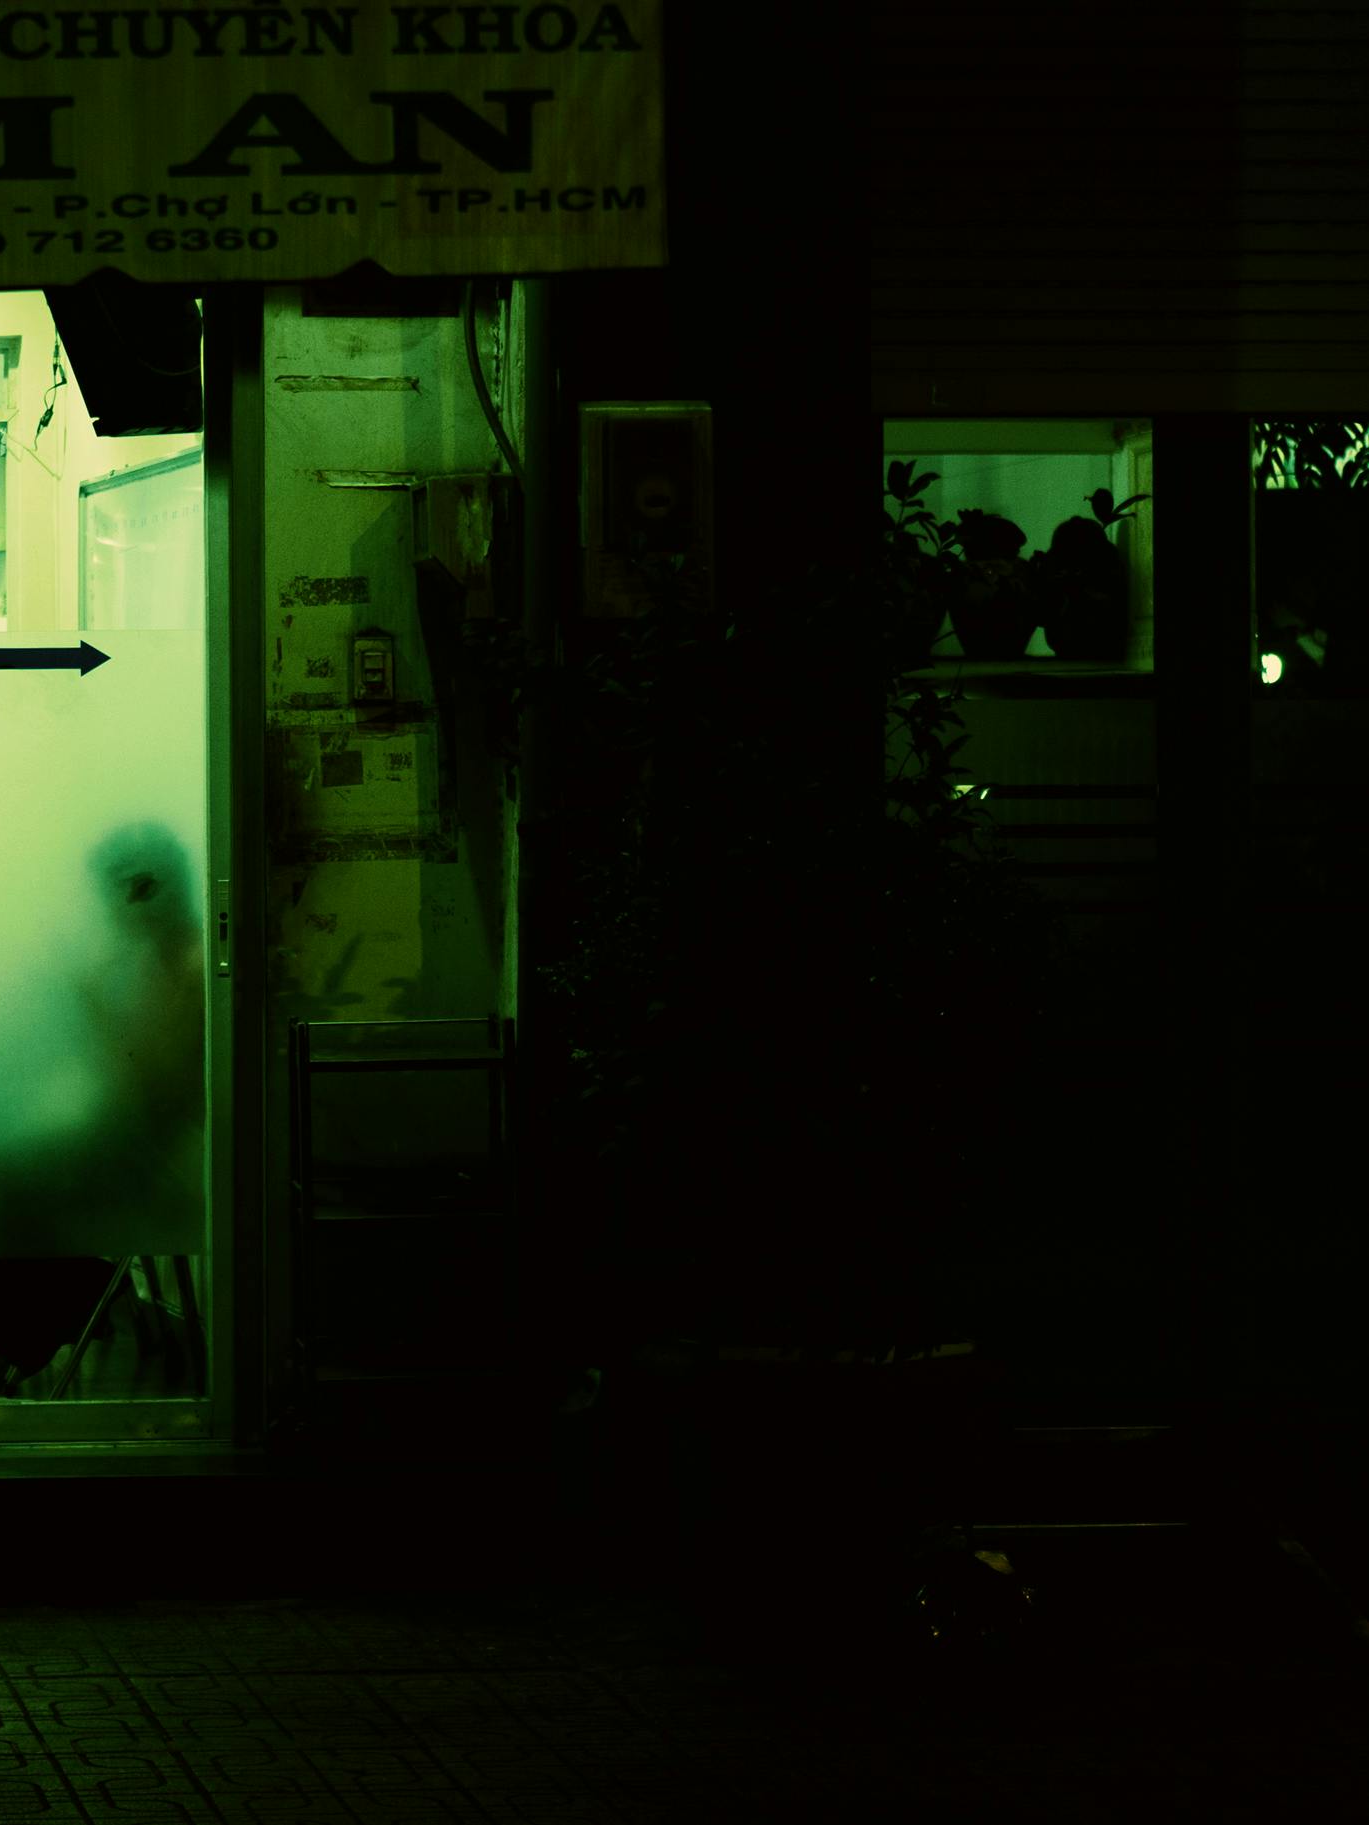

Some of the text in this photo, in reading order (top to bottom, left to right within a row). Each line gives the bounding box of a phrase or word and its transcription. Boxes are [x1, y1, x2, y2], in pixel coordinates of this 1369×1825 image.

[391, 4, 642, 56] KHOA
[169, 89, 553, 178] AN
[55, 191, 229, 223] P.Chợ
[253, 188, 358, 217] Lớn
[416, 185, 647, 215] TP.HCM
[26, 231, 124, 255] 712
[147, 228, 278, 253] 6360
